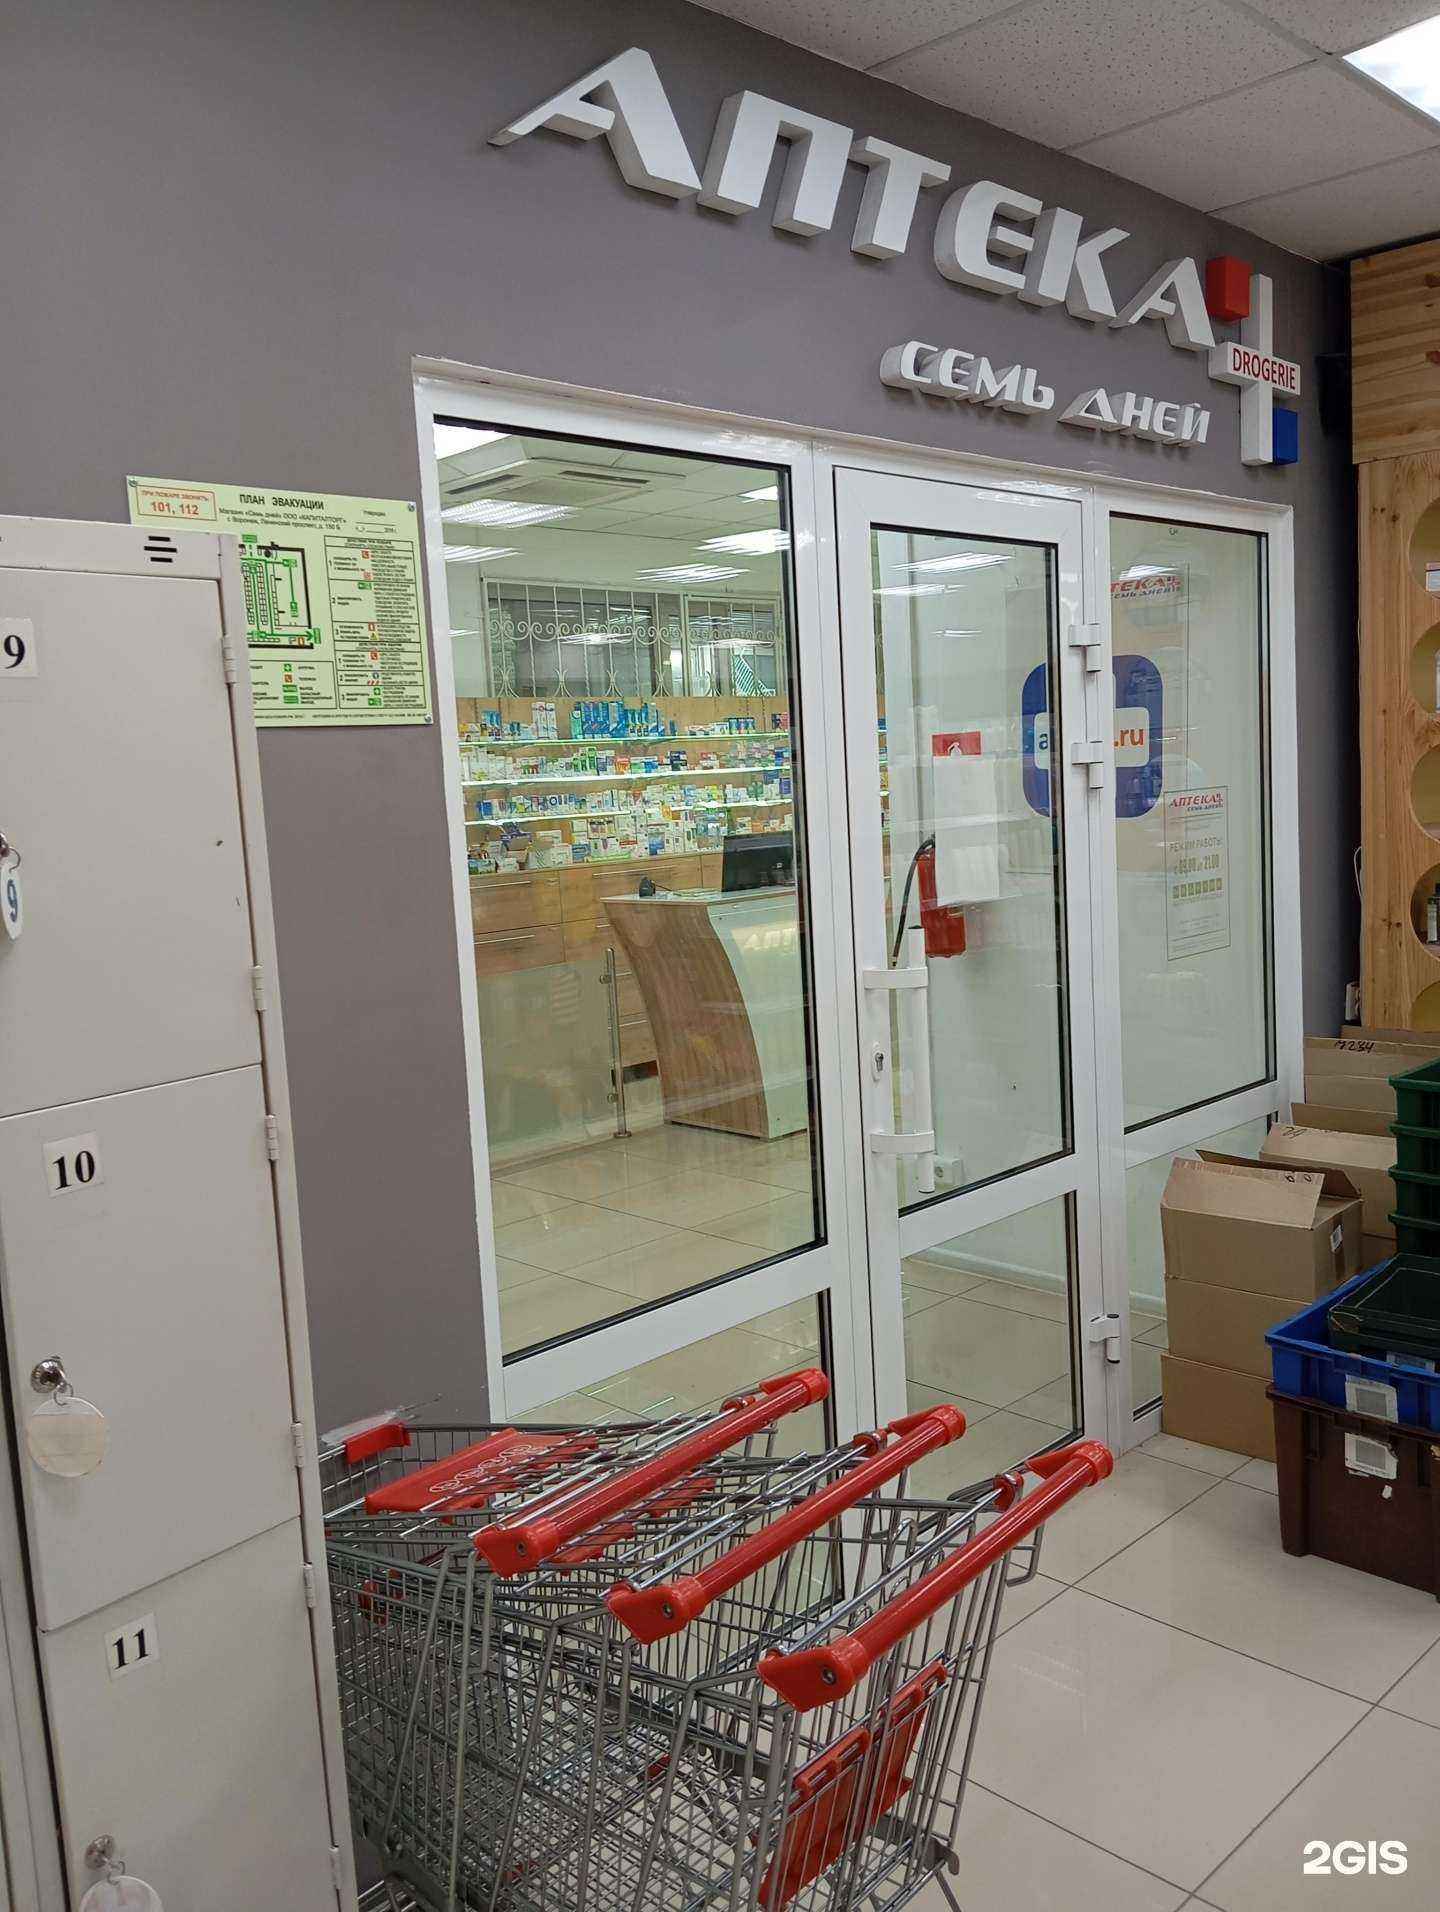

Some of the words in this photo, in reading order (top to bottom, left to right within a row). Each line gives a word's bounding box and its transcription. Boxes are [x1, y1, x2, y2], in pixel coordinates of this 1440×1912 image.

[488, 47, 1216, 351] АПТЕКА
[1232, 347, 1297, 390] DROGERIE
[882, 340, 1055, 414] СЕМЬ
[1057, 387, 1211, 447] ДНЕЙ
[151, 501, 175, 514] 101,
[179, 503, 199, 515] 112
[239, 494, 265, 505] ПЛАН
[272, 497, 324, 510] ЭВАКУАЦИИ
[1110, 577, 1165, 592] ТЕКА
[4, 635, 26, 669] 9
[1169, 793, 1216, 808] АПТЕКА
[53, 1150, 95, 1190] 10
[112, 1628, 152, 1670] 11
